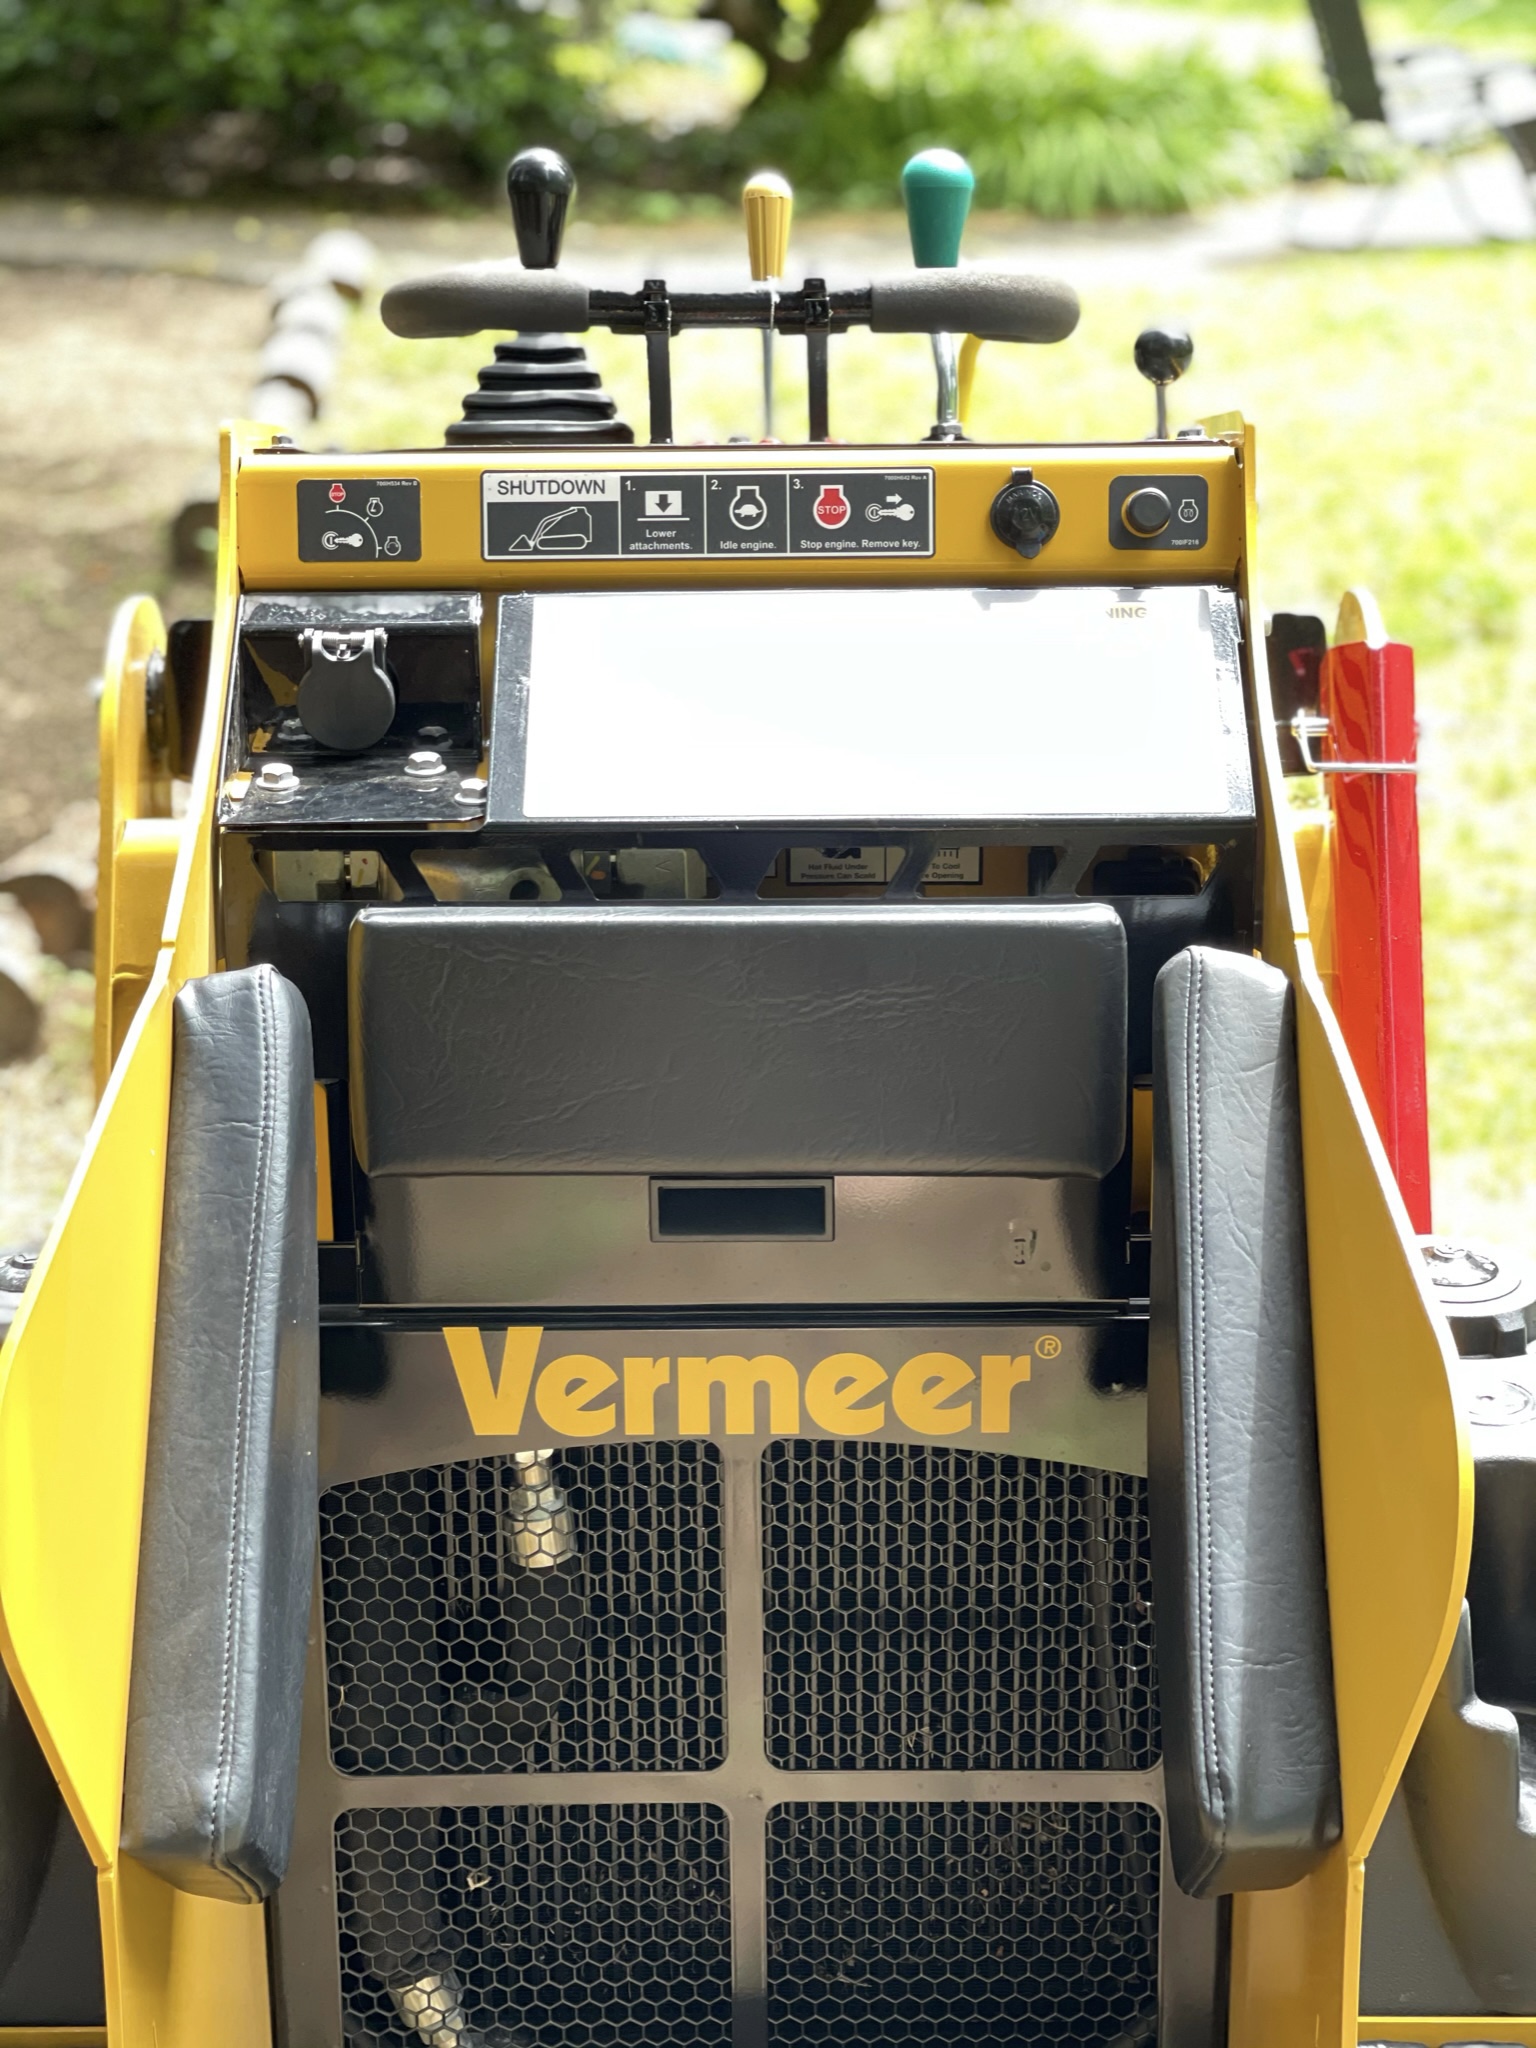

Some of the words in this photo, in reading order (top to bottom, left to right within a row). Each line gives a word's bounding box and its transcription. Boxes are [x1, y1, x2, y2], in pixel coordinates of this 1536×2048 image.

[496, 479, 606, 496] SHUTDOWN
[625, 480, 636, 491] 1.
[711, 479, 722, 490] 2.
[793, 478, 804, 490] 3.
[817, 505, 846, 515] STOP
[645, 529, 677, 539] Lower
[629, 541, 693, 551] attachments.
[720, 540, 738, 549] Idle
[739, 541, 777, 551] engine.
[800, 540, 819, 551] Stop
[821, 540, 859, 551] engine.
[861, 539, 899, 549] Remove
[901, 539, 921, 551] key.
[823, 863, 843, 871] Fluid
[844, 863, 868, 871] Under
[836, 872, 852, 880] Can
[852, 872, 876, 880] Scald
[931, 872, 964, 881] Opening
[442, 1326, 1032, 1438] Vermeer
